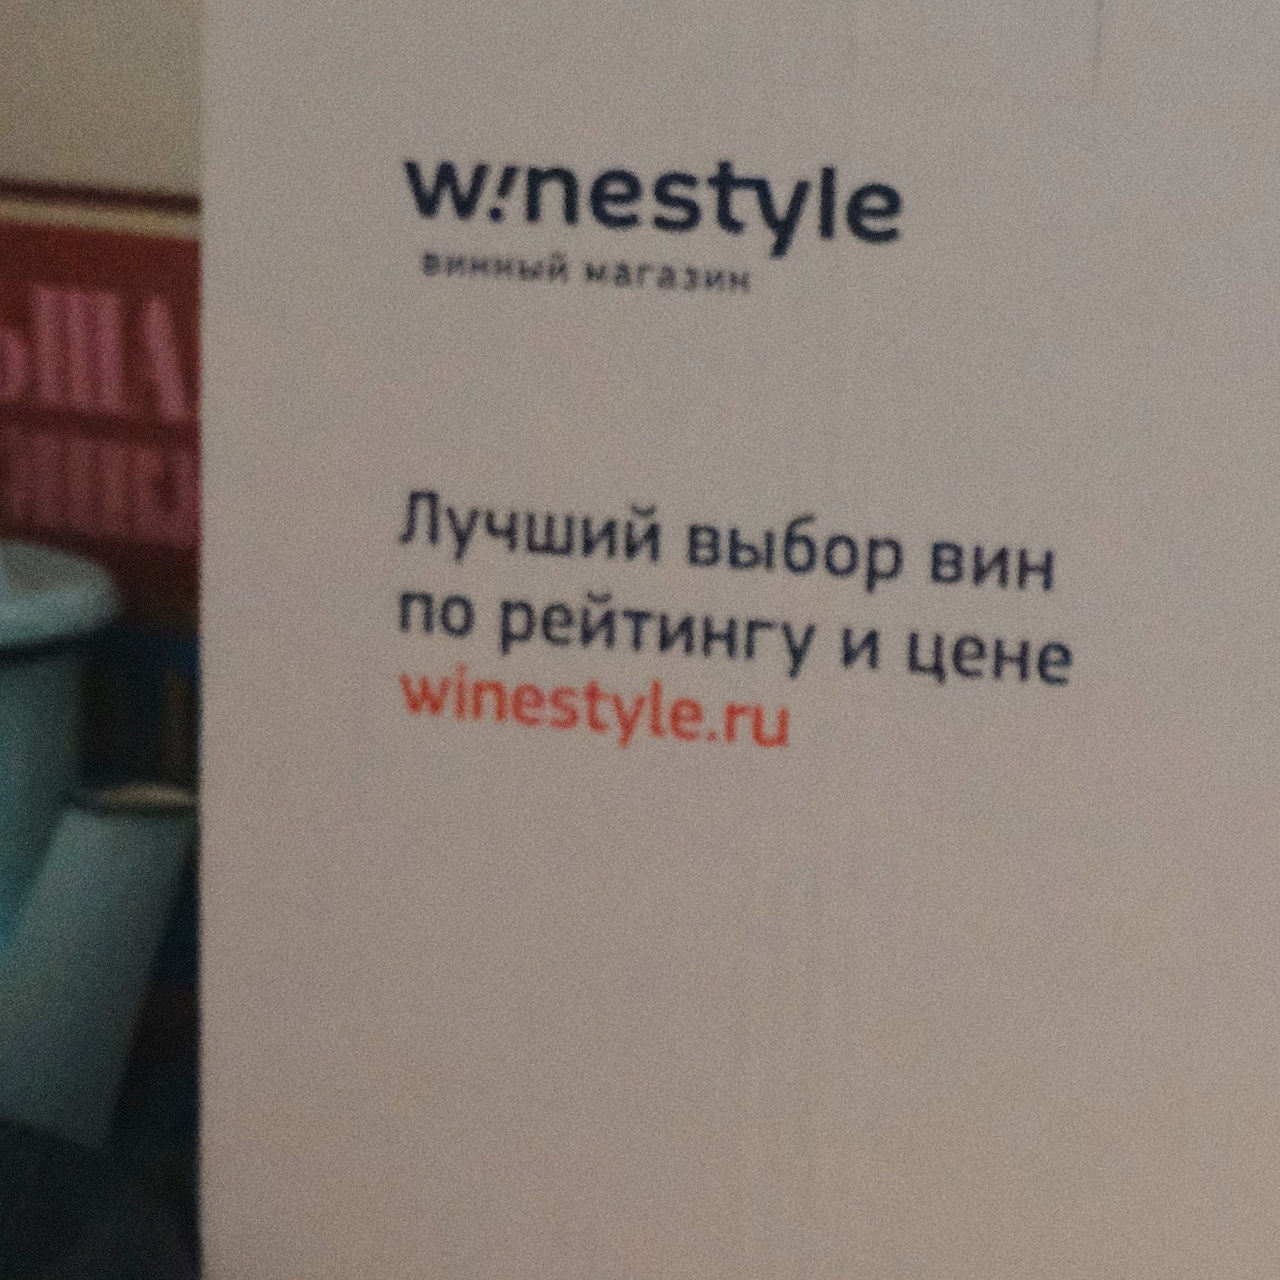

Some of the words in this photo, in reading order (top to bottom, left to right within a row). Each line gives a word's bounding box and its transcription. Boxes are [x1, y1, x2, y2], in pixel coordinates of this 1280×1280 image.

[421, 250, 569, 285] винный
[583, 260, 751, 293] магазин
[398, 488, 662, 563] Лучший
[686, 513, 905, 595] выбор
[928, 539, 1056, 593] вин
[397, 590, 477, 640] по
[498, 591, 818, 681] рейтингу
[839, 626, 881, 671] и
[906, 630, 1075, 688] цене
[399, 665, 790, 749] winestyle.ru
